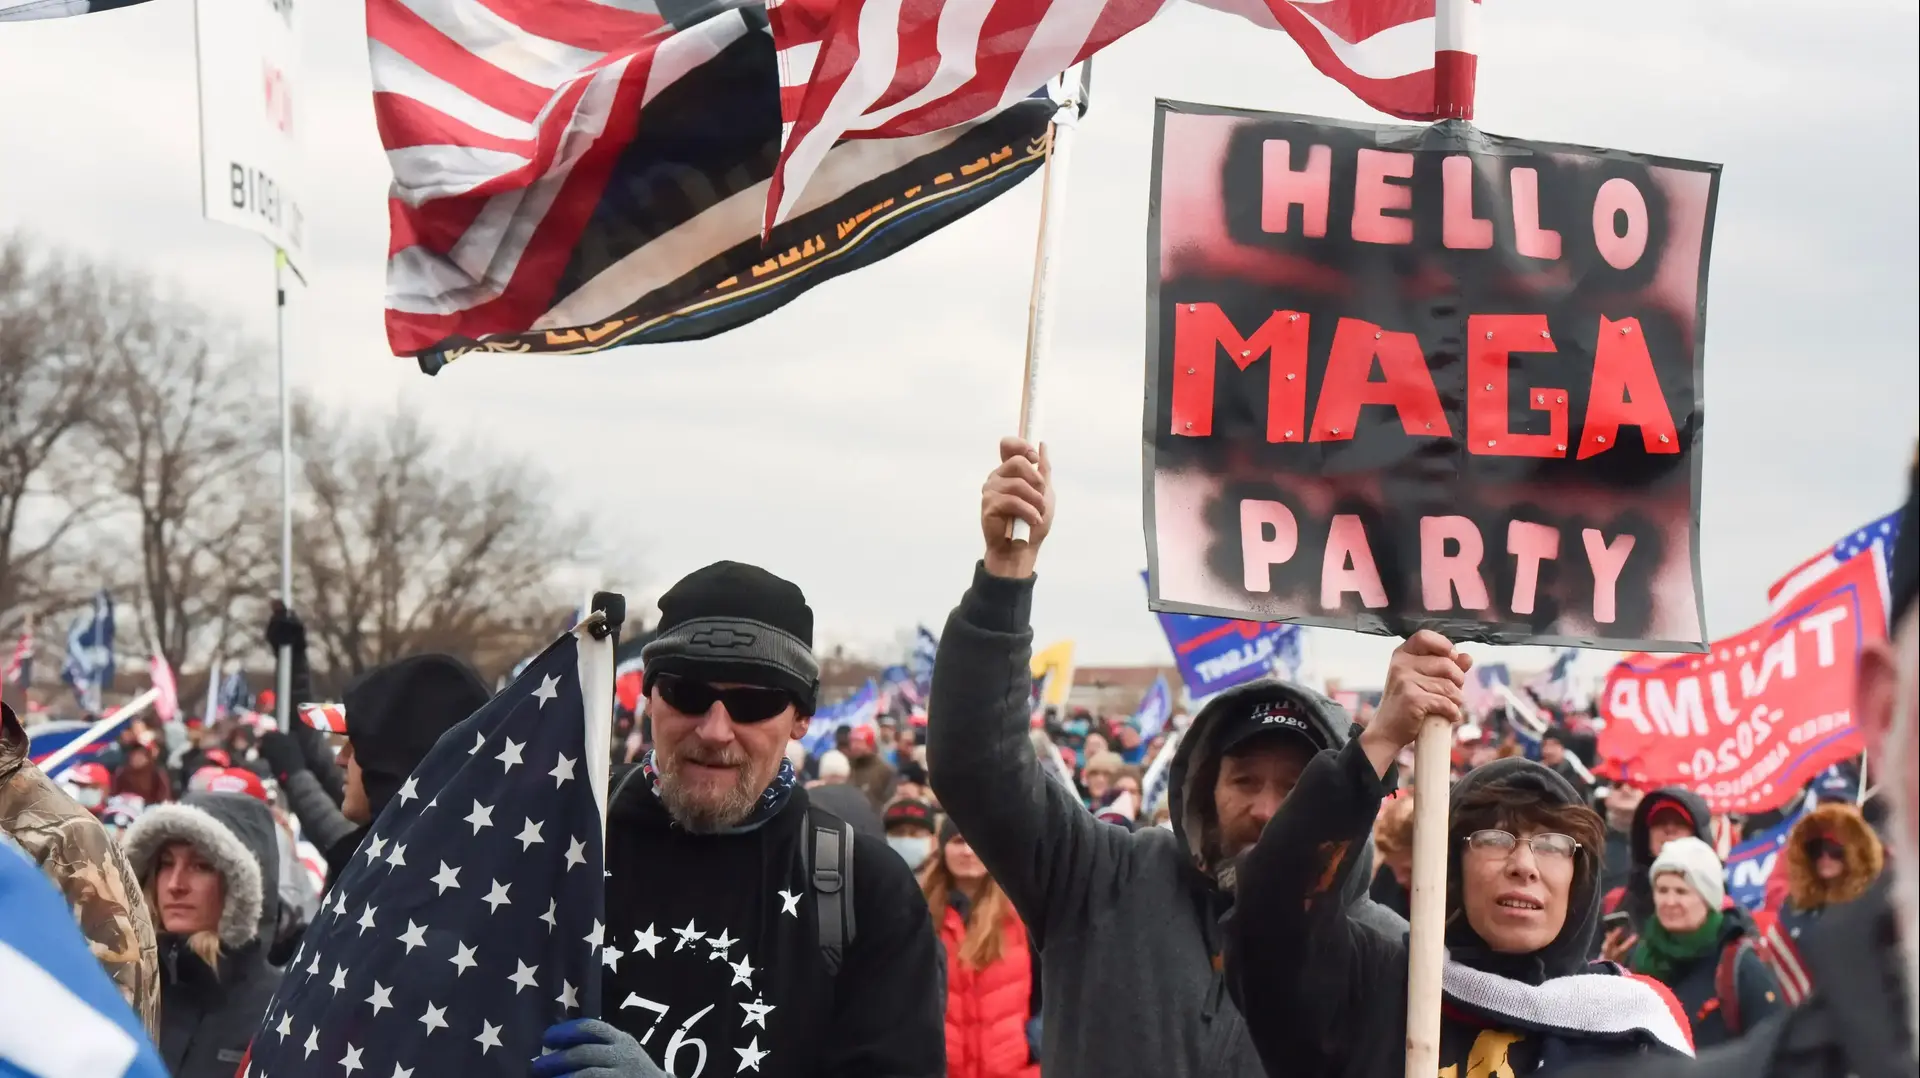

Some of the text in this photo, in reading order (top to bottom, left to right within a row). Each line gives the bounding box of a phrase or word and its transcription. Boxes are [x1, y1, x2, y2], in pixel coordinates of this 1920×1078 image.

[1261, 139, 1649, 270] HELLO
[1171, 302, 1681, 460] MAGA
[1240, 499, 1636, 623] PARTY
[1262, 715, 1308, 729] 2020
[620, 991, 715, 1078] 76
